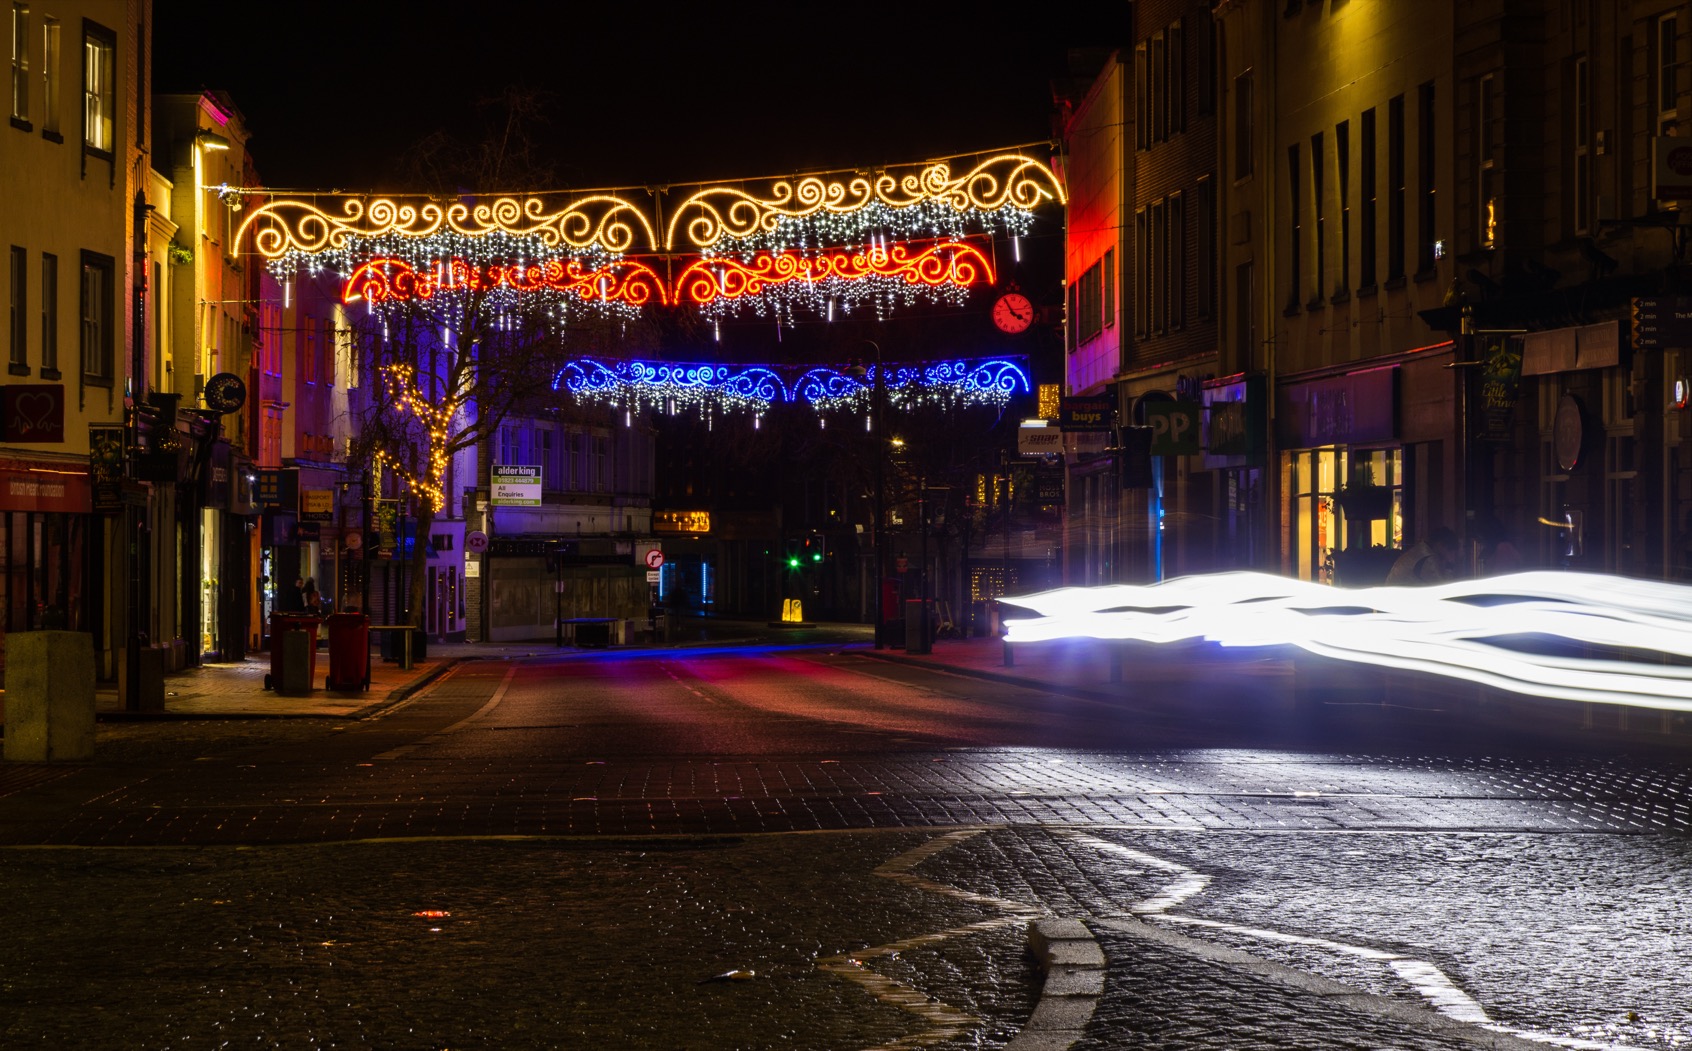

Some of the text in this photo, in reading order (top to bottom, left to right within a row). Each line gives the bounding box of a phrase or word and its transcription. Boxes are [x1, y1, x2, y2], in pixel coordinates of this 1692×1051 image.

[1482, 382, 1506, 398] Little
[1064, 400, 1109, 412] bargain
[1072, 410, 1101, 423] buys
